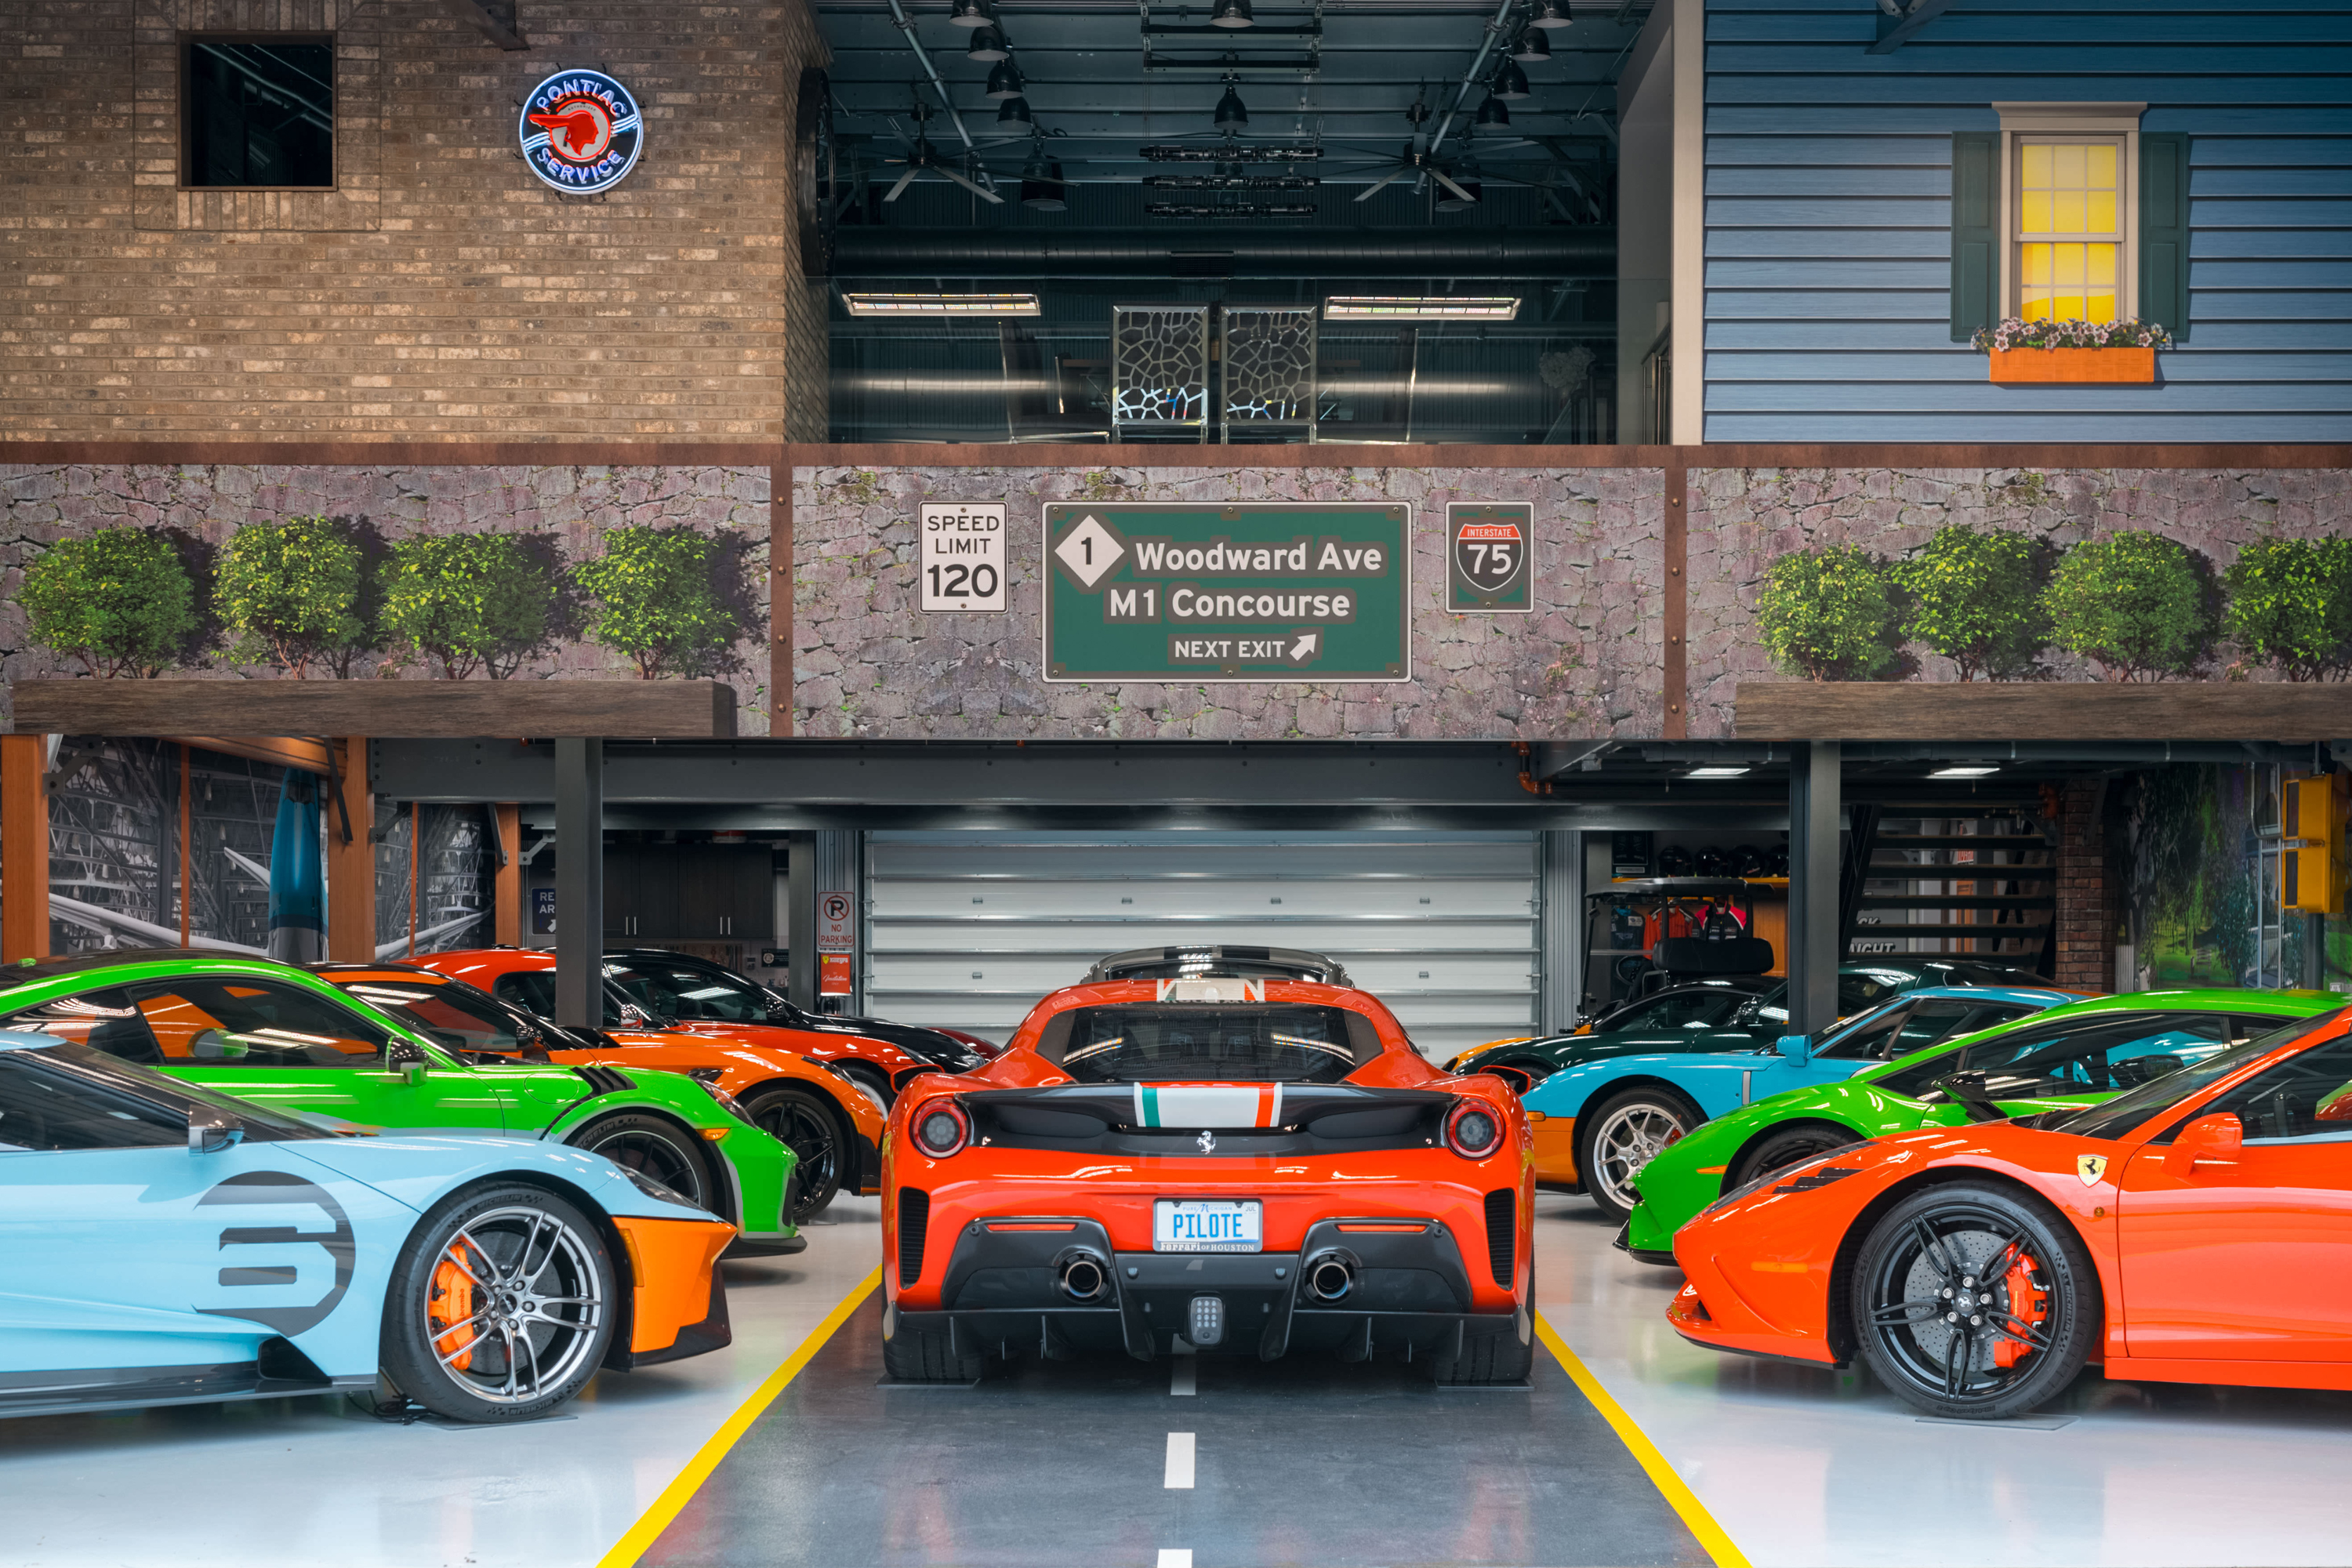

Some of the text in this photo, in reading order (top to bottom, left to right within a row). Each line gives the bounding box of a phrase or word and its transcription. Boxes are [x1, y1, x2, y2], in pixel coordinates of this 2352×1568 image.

[536, 79, 628, 118] PONTIAC
[537, 147, 626, 183] SERVICE
[927, 516, 1000, 532] SPEED
[1467, 528, 1512, 537] INTERSTATE
[935, 538, 991, 554] LIMIT
[1080, 536, 1382, 571] 1 Woodward Ave
[1467, 544, 1512, 575] 75
[927, 564, 998, 597] 120
[1110, 589, 1350, 617] M1 Concourse
[1174, 641, 1285, 658] NEXT EXIT
[540, 892, 555, 901] RE
[539, 905, 555, 913] AR
[821, 935, 852, 944] PARKING
[476, 1194, 522, 1209] MICHELIN
[1196, 1203, 1232, 1213] MICHIGAN
[1173, 1214, 1243, 1238] PILOTE
[1160, 1242, 1200, 1251] Ferrari
[2064, 1284, 2073, 1331] MICHELIN
[508, 1399, 554, 1416] MICHELIN
